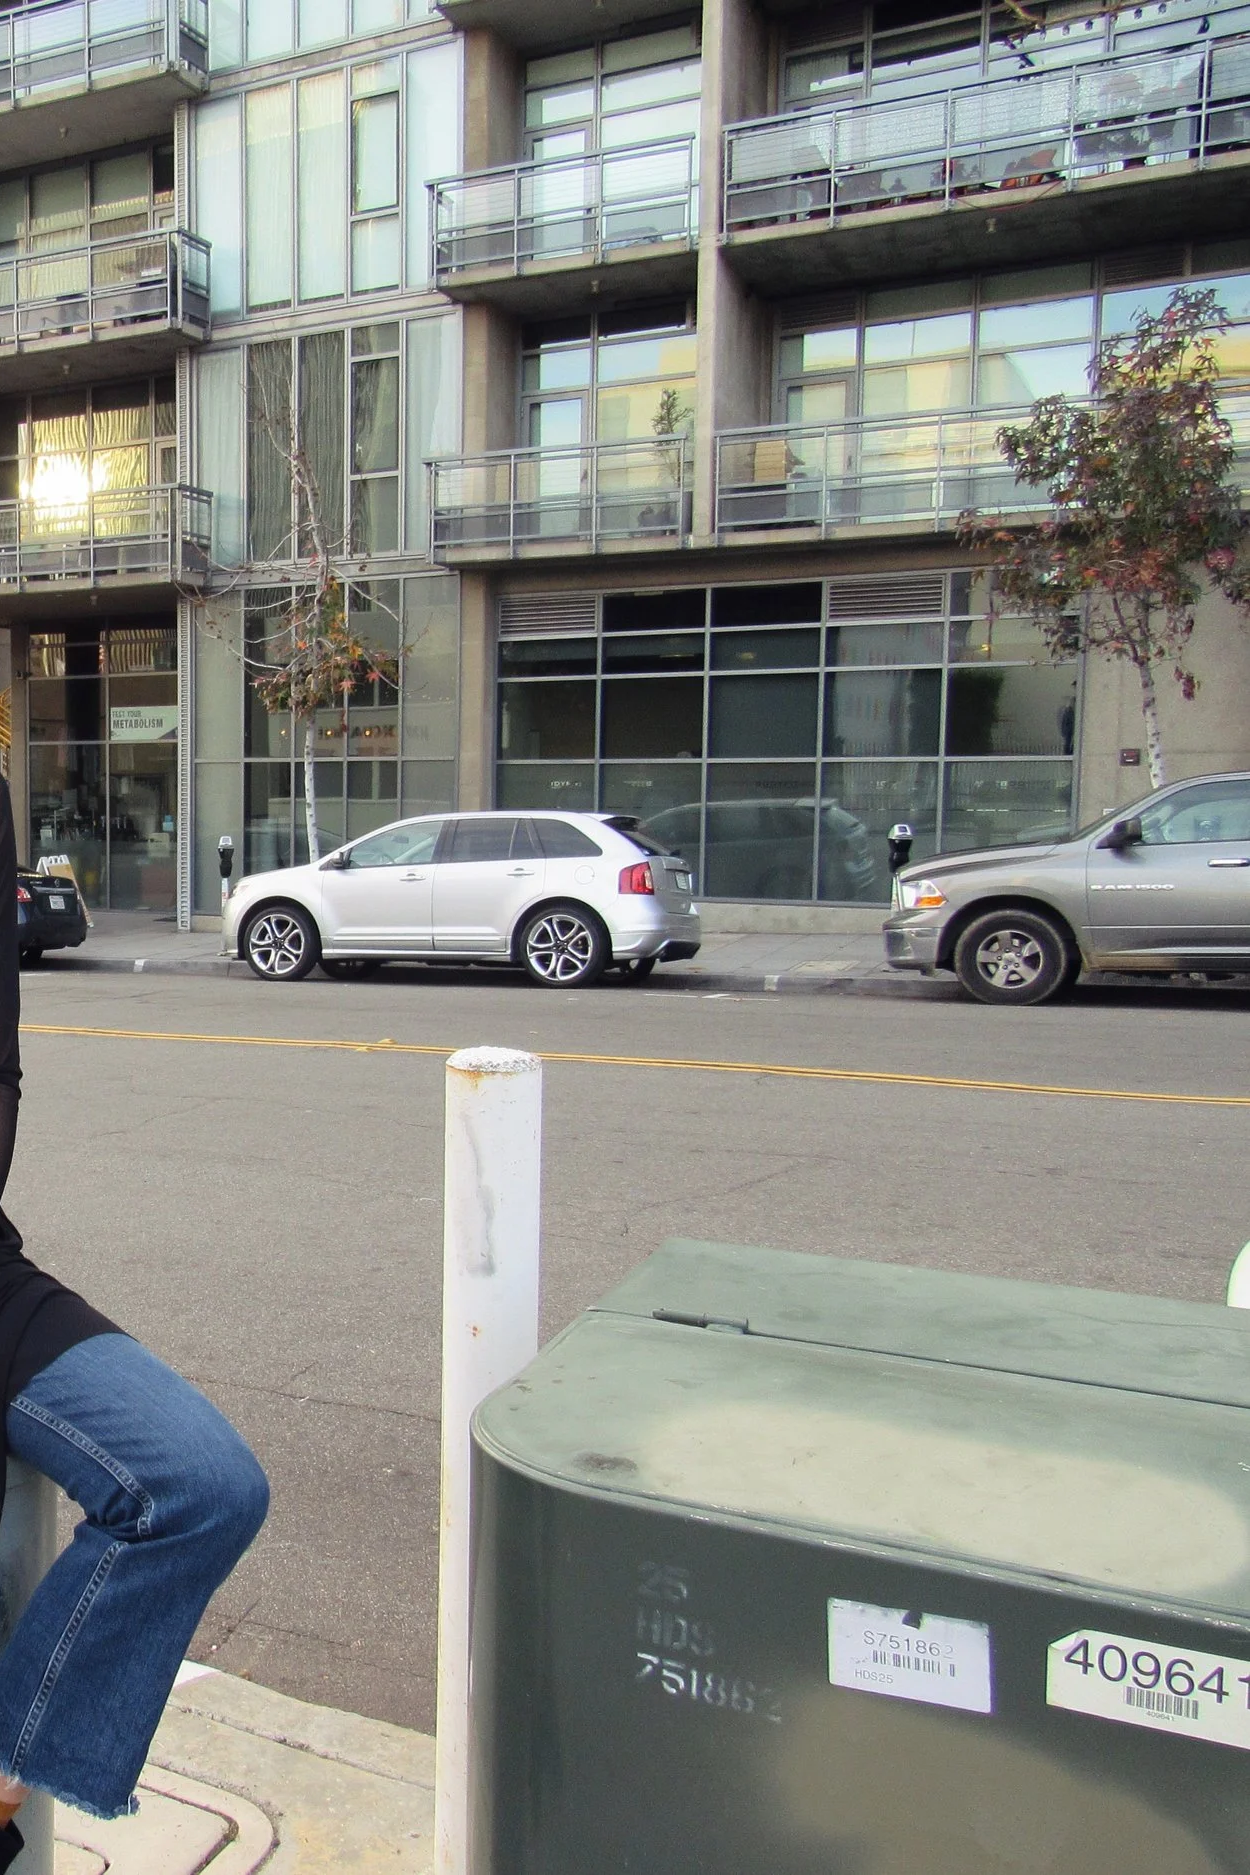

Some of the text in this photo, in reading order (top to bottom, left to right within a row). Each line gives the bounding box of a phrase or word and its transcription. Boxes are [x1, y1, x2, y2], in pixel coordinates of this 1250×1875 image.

[113, 718, 163, 729] METABOLISM
[863, 1629, 955, 1660] S751862
[854, 1668, 895, 1684] HDS25
[1064, 1638, 1250, 1710] 409641
[1146, 1711, 1175, 1722] 409641
